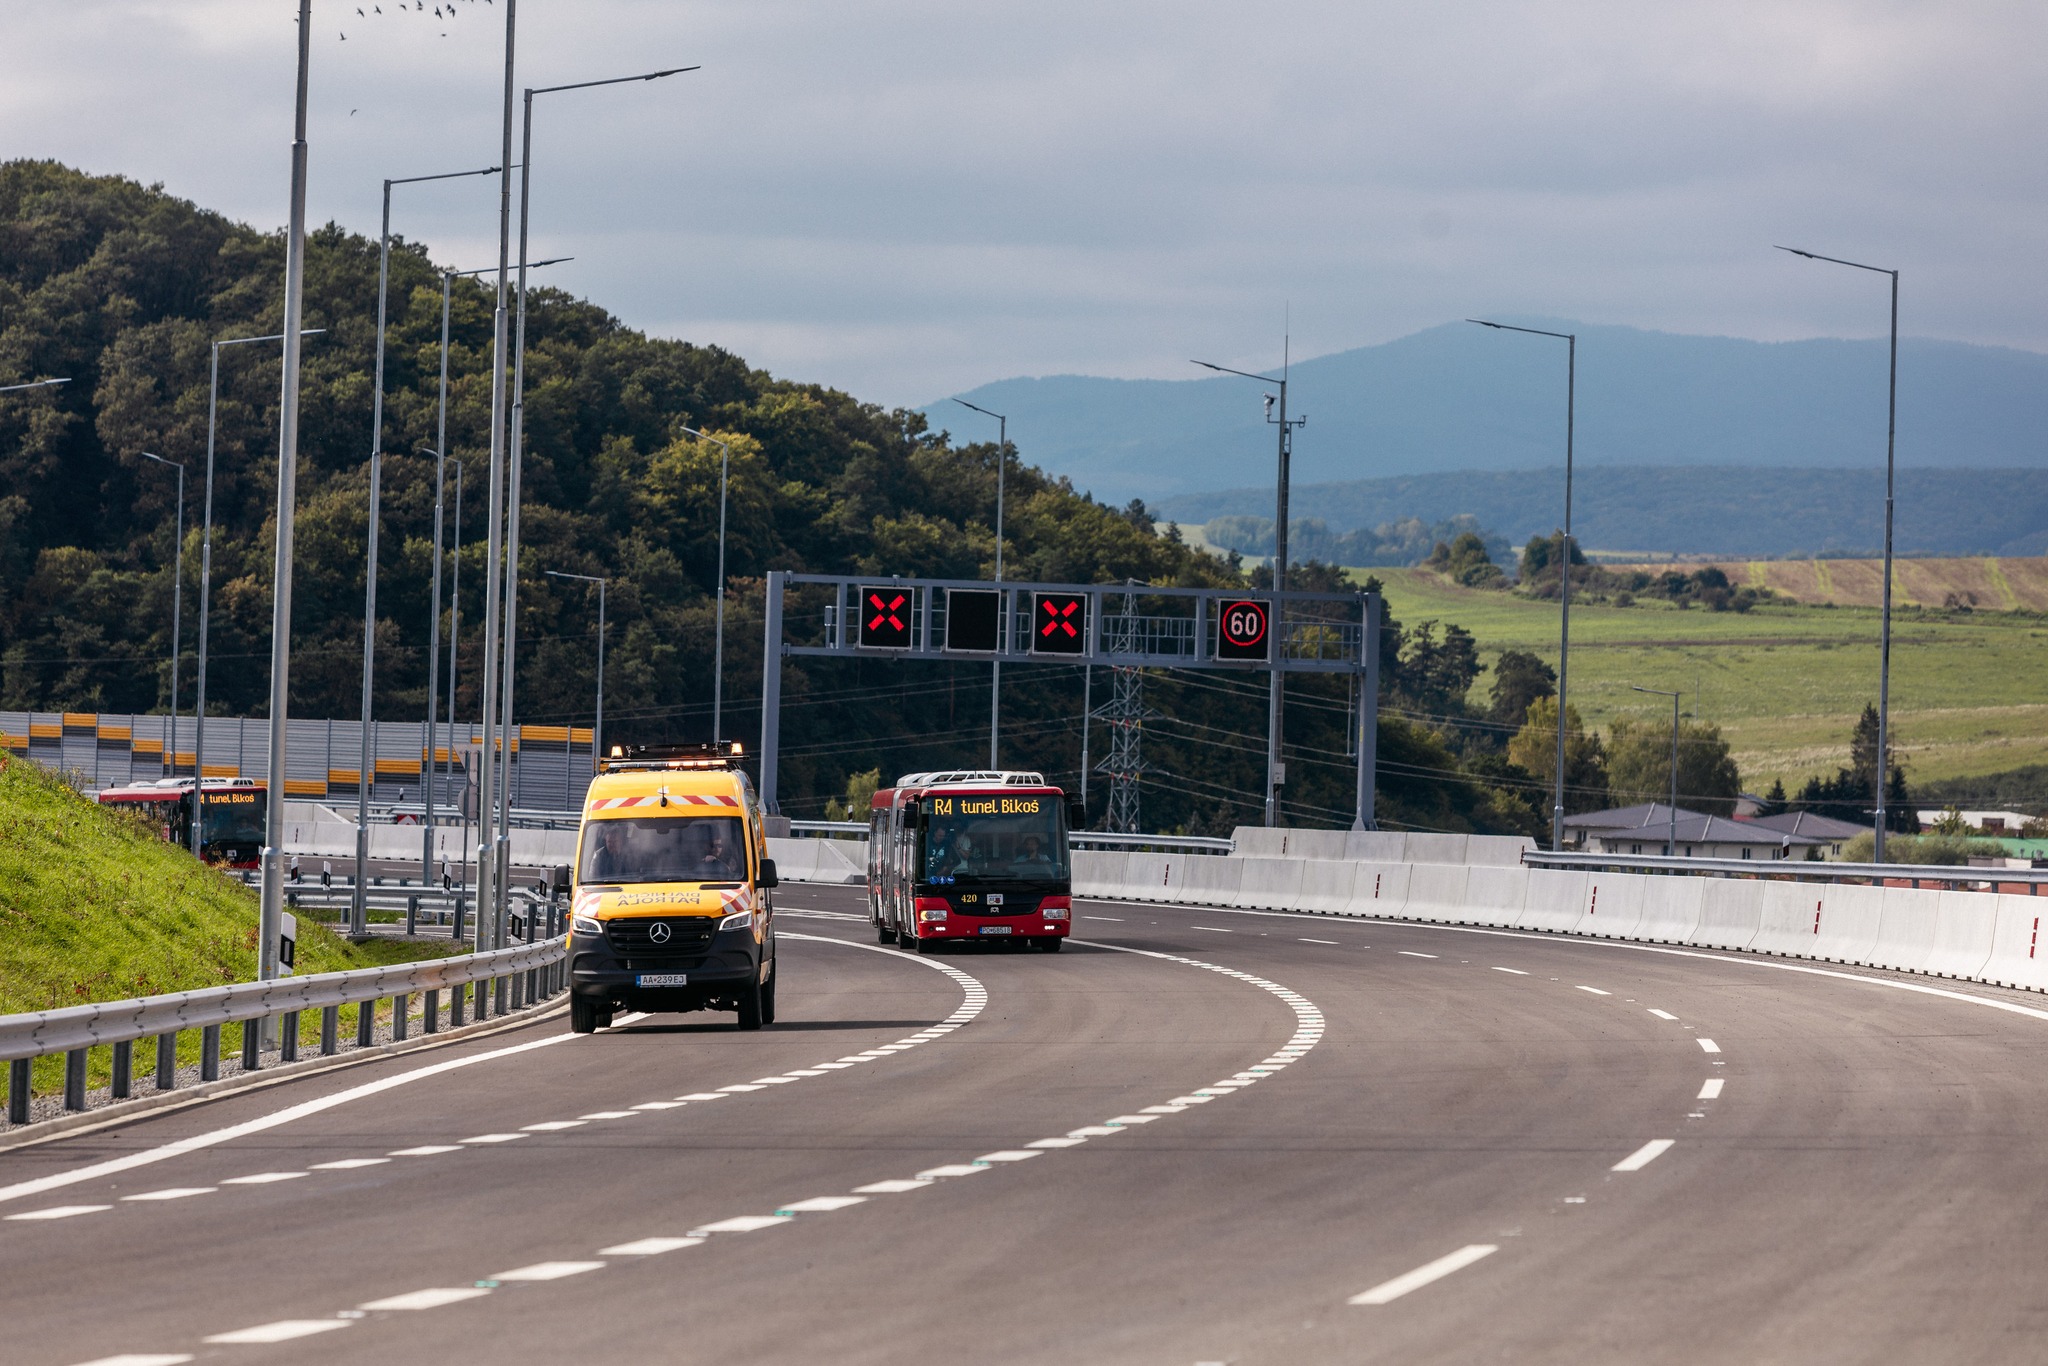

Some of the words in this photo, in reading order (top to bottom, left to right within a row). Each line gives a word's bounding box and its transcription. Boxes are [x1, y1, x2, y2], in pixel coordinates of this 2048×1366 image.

[1231, 611, 1257, 636] 60
[209, 794, 231, 804] tunel
[934, 798, 952, 815] R4
[960, 799, 998, 814] tunel
[1001, 799, 1039, 814] Bikoš
[960, 894, 978, 903] 420
